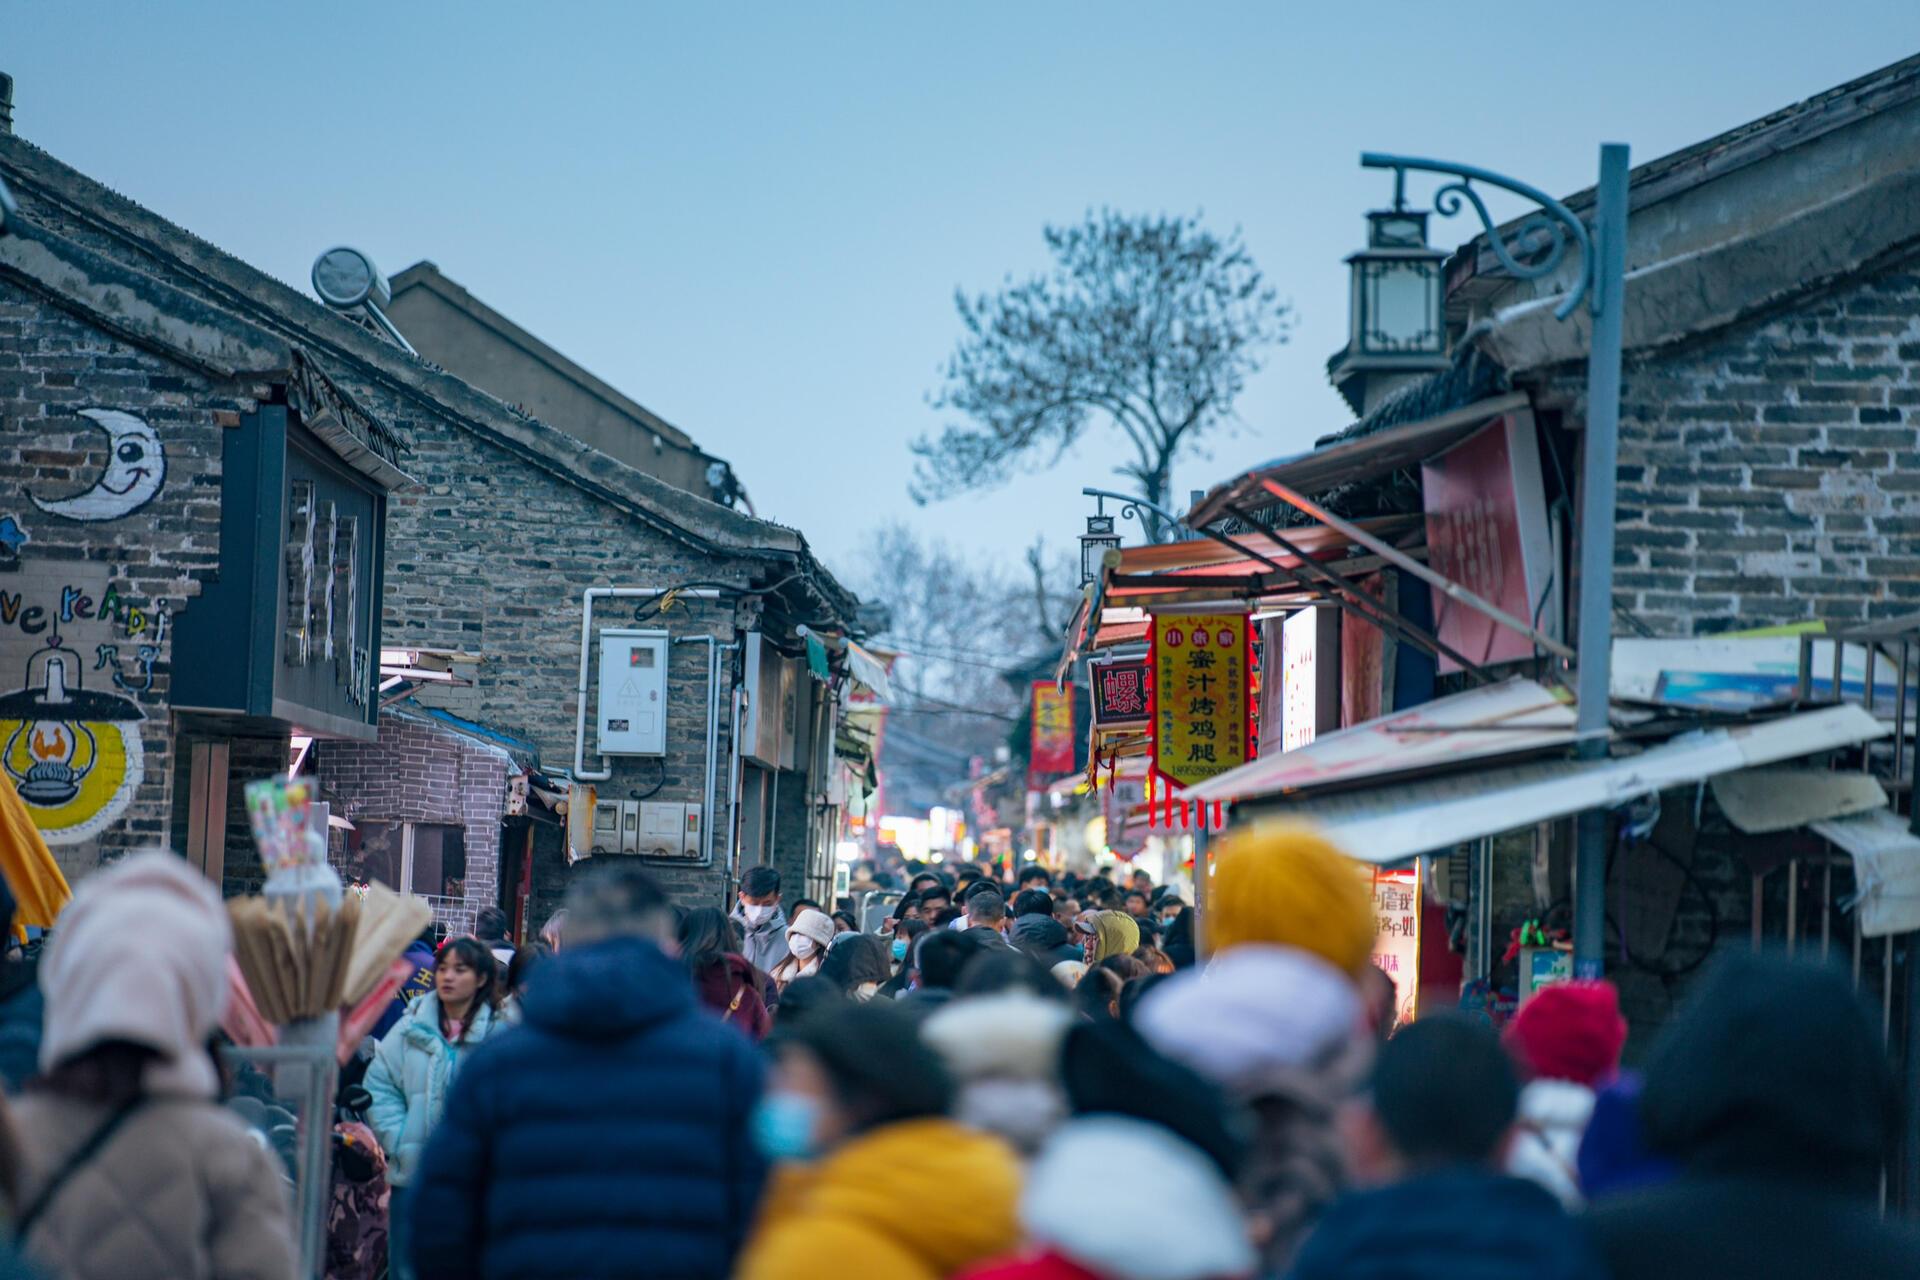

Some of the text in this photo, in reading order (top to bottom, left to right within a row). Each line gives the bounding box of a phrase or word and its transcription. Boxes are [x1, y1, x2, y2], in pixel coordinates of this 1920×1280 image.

[1105, 671, 1151, 713] 螺
[1187, 649, 1216, 762] 蜜汁烤鸡腿
